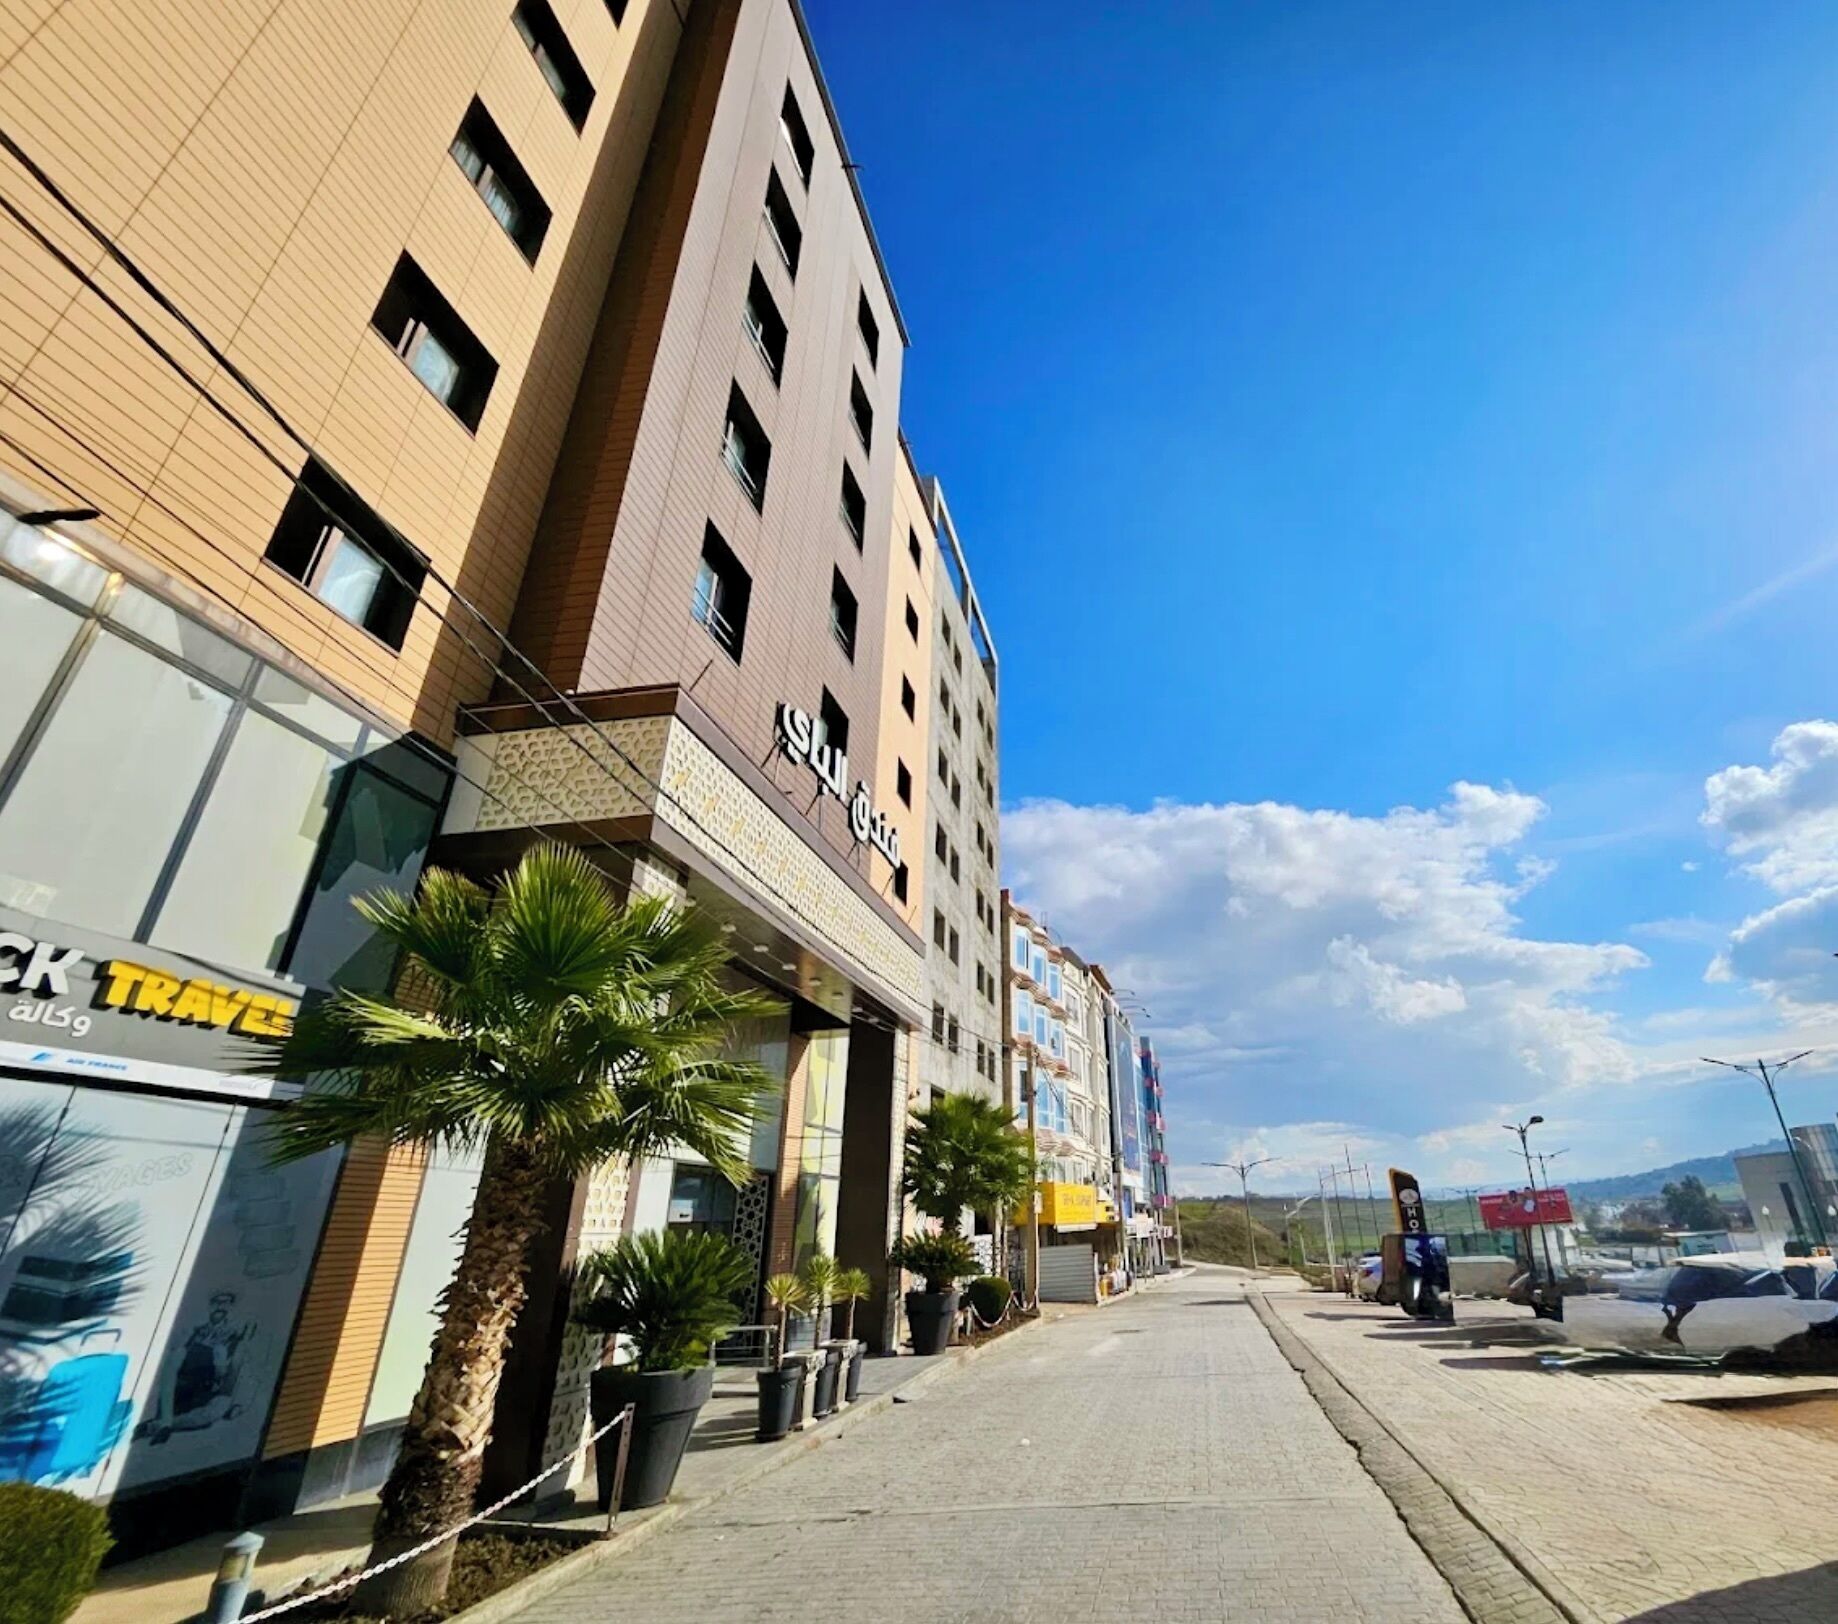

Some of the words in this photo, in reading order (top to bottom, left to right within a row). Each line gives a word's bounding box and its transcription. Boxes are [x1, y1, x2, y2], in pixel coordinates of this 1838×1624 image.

[852, 780, 901, 868] فندق
[8, 1000, 92, 1037] وكالة
[1406, 1207, 1420, 1233] HO
